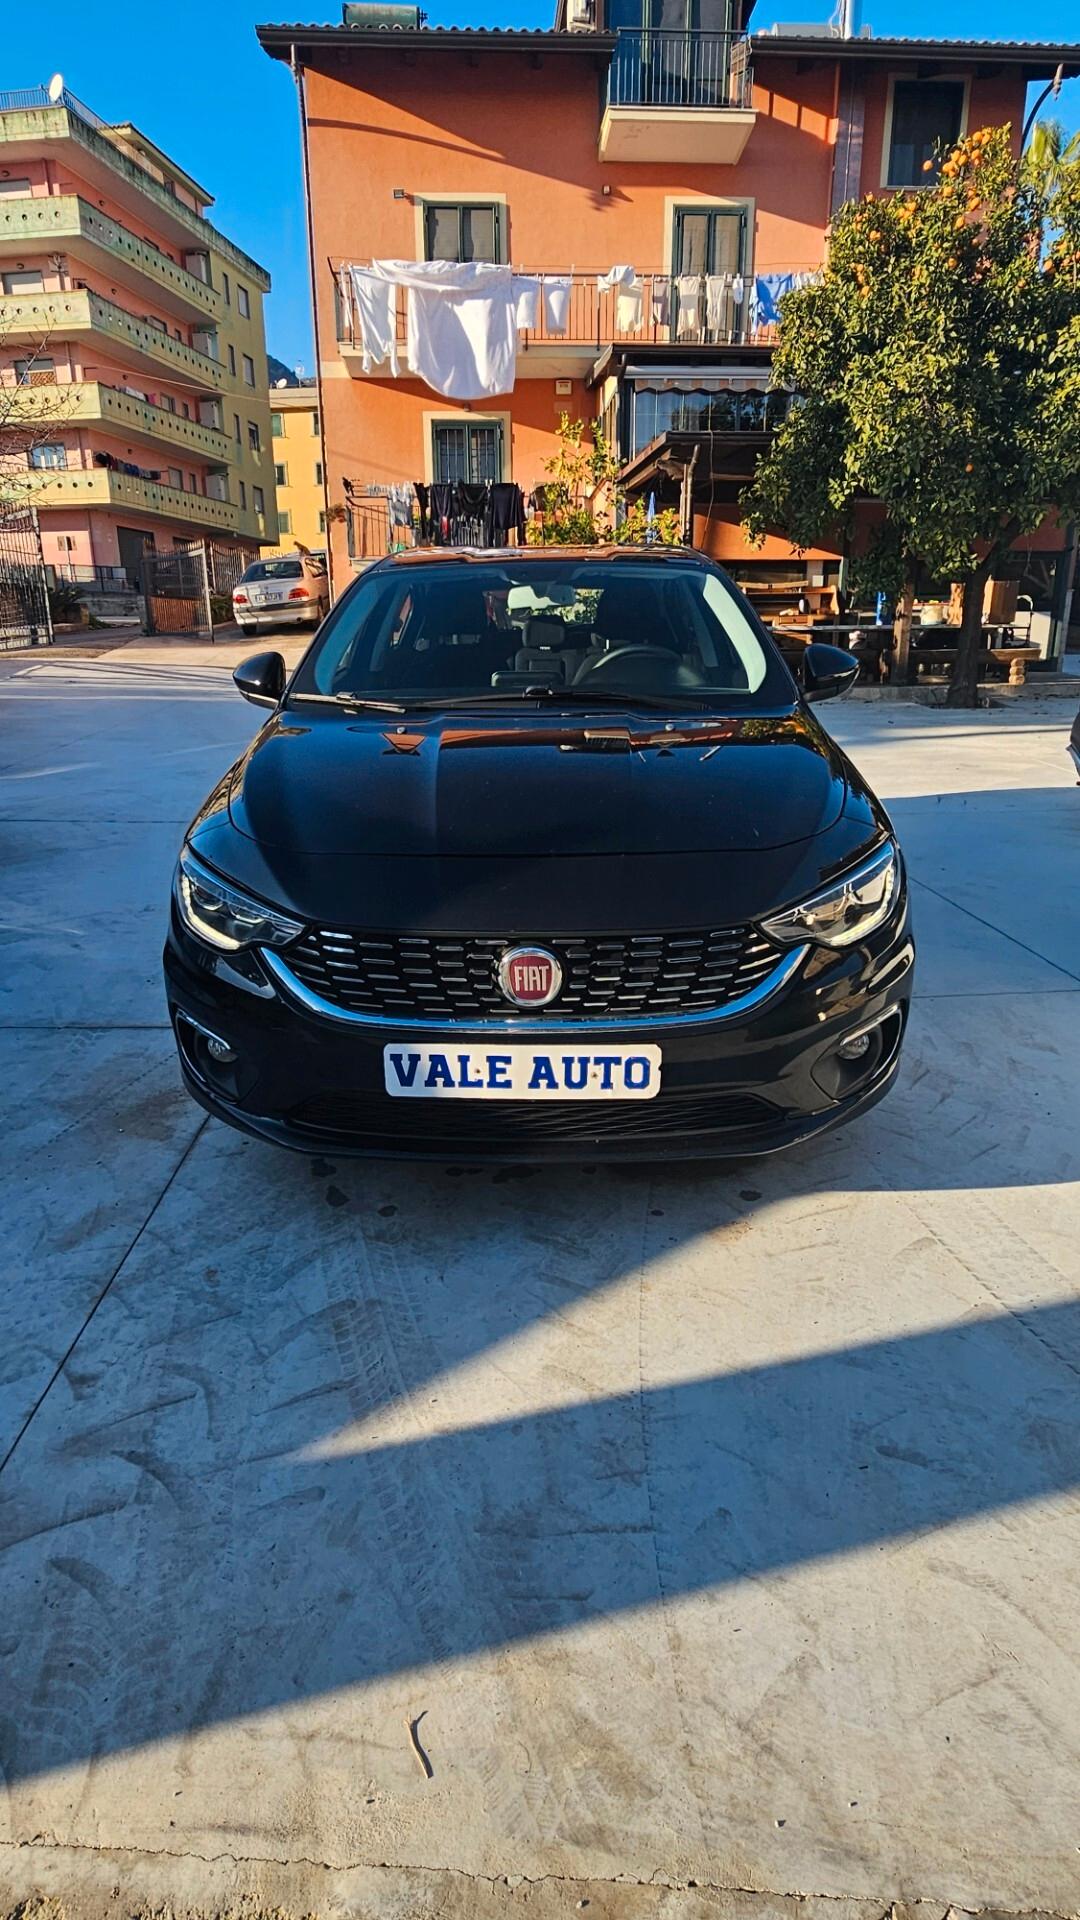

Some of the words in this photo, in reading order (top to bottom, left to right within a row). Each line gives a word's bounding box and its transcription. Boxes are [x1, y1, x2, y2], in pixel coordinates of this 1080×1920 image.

[514, 966, 549, 992] FIAT
[390, 1053, 512, 1089] VALE
[528, 1056, 651, 1090] AUTO
